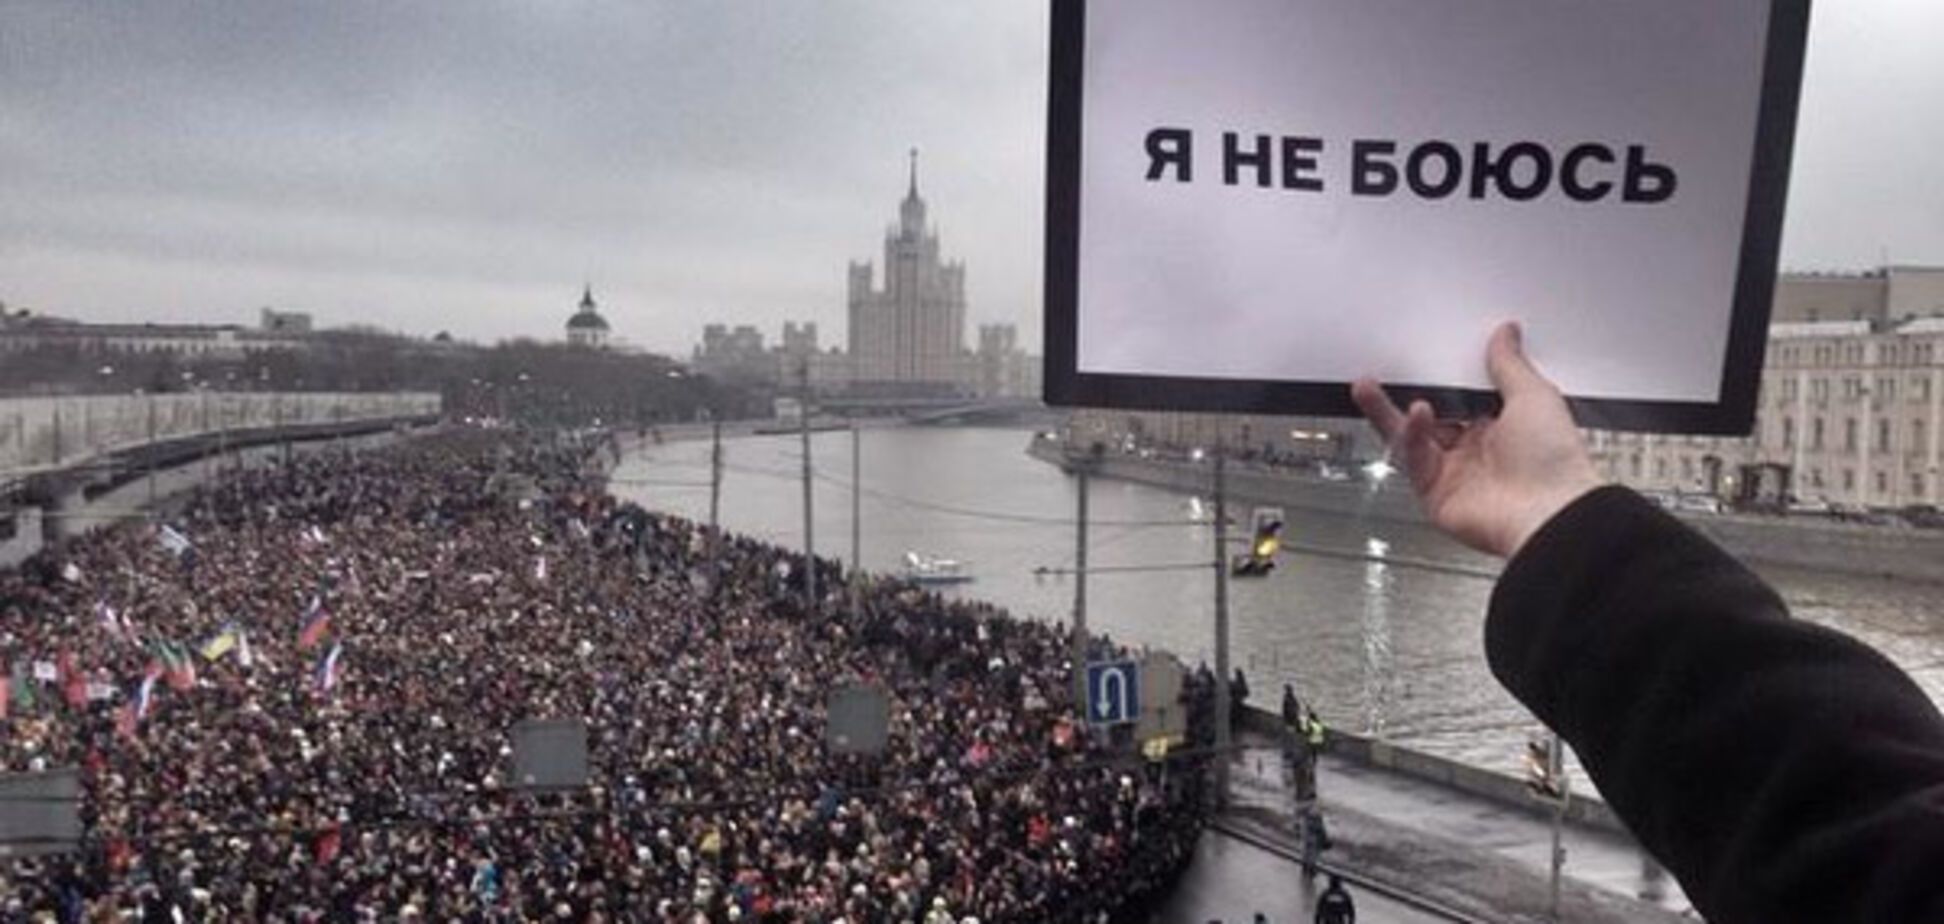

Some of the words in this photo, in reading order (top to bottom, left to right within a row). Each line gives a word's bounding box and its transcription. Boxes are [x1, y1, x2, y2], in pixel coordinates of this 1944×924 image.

[1144, 128, 1192, 183] Я
[1223, 132, 1324, 192] НЕ
[1351, 139, 1680, 204] БОЮСЬ
